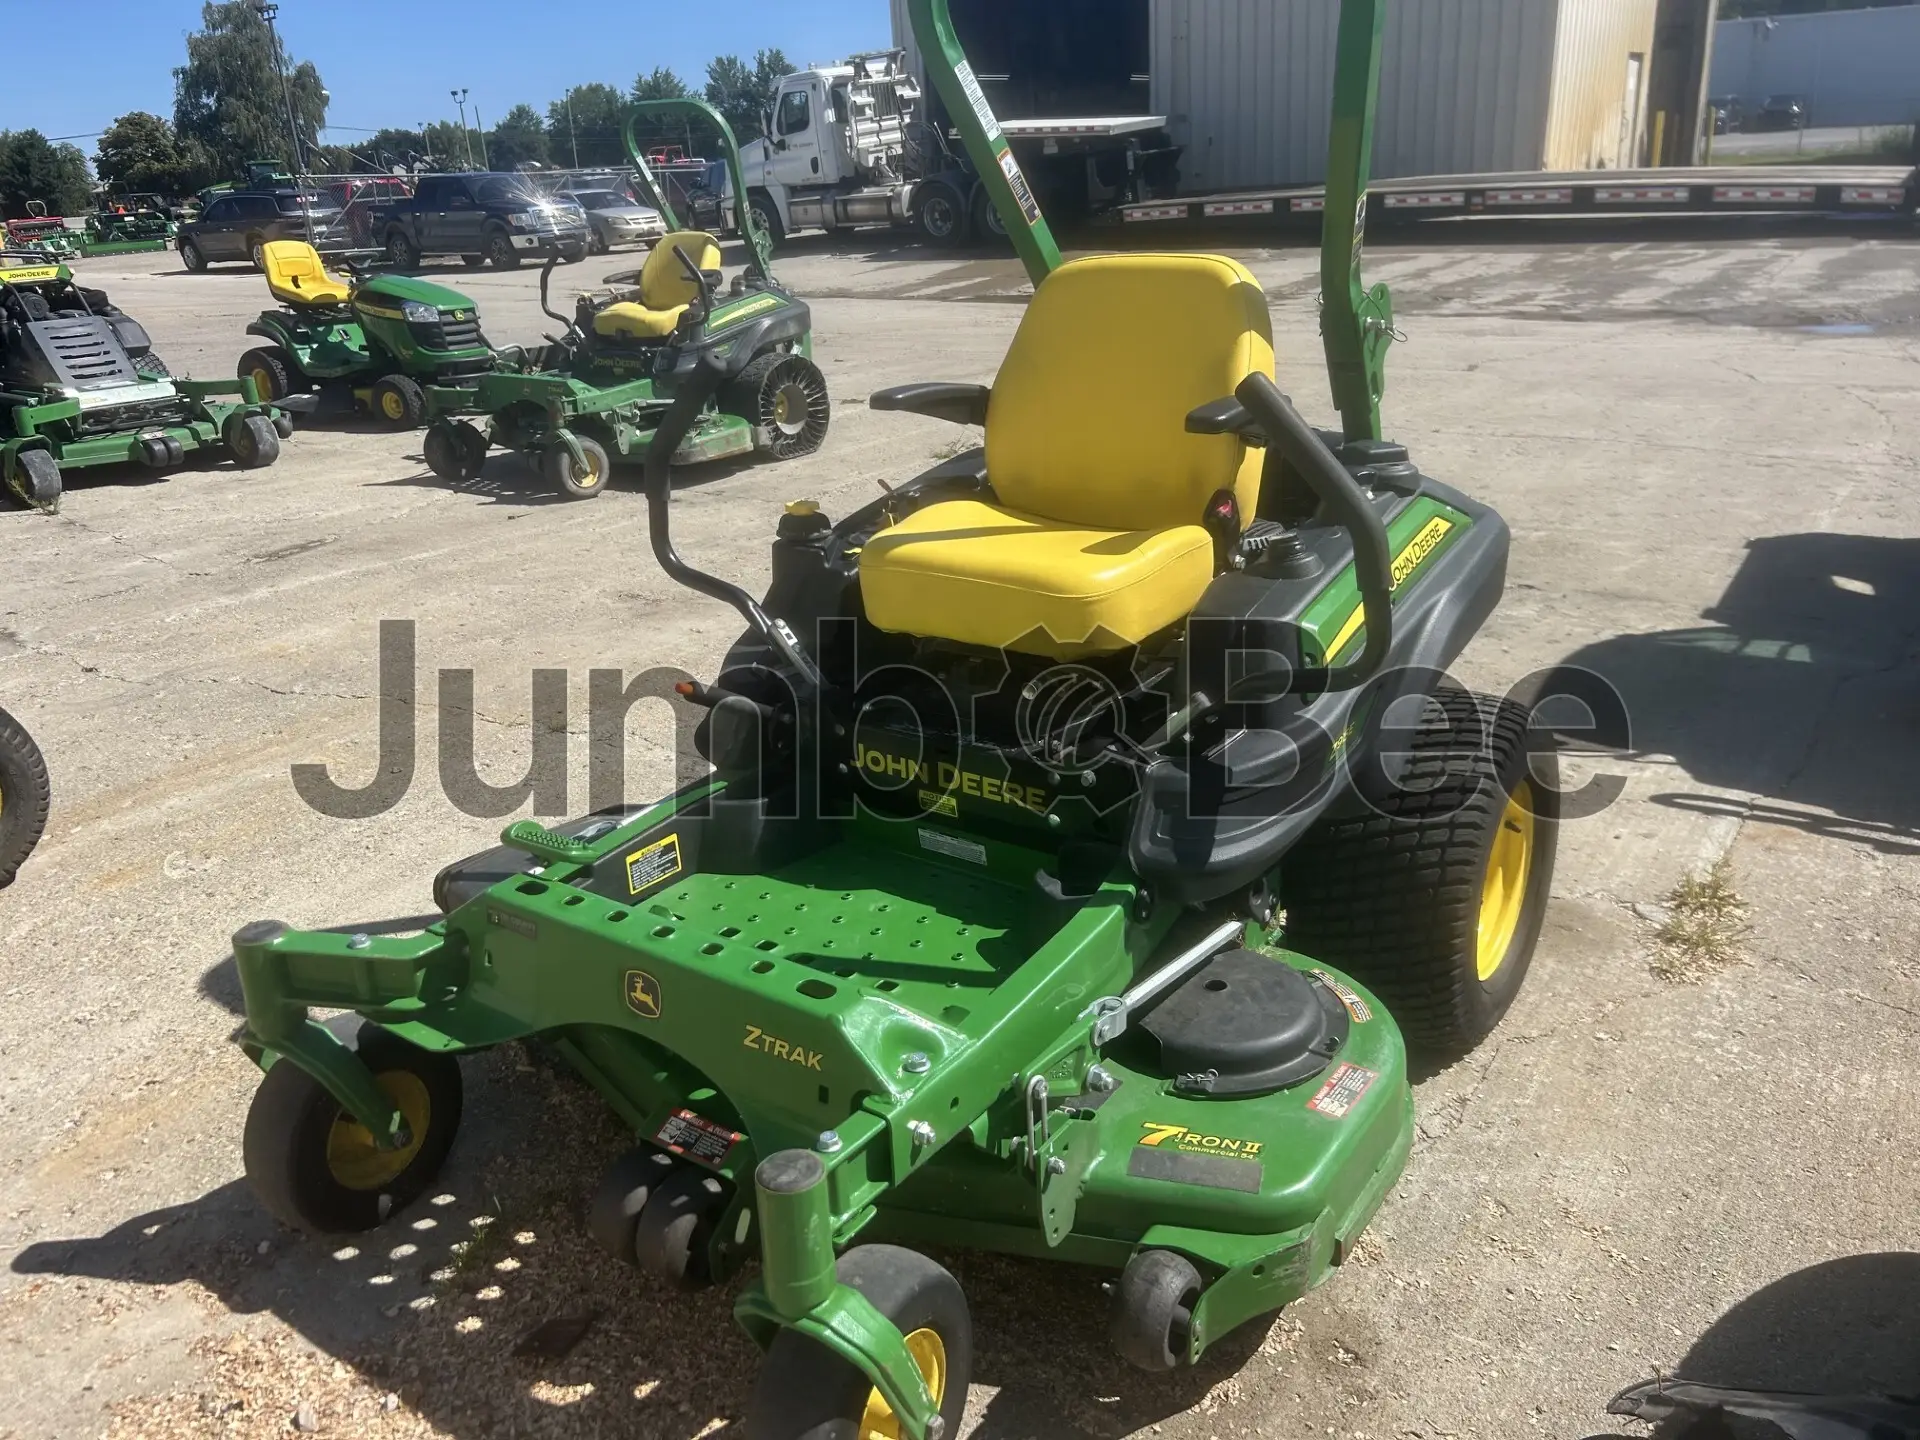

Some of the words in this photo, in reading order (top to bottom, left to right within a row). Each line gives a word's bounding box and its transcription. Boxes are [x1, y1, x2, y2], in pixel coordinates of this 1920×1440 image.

[1411, 523, 1443, 561] DEERE
[850, 743, 929, 784] JOHN
[937, 761, 1046, 812] DEERE
[743, 1024, 824, 1072] ZTRAK
[1178, 1144, 1239, 1157] Commercial
